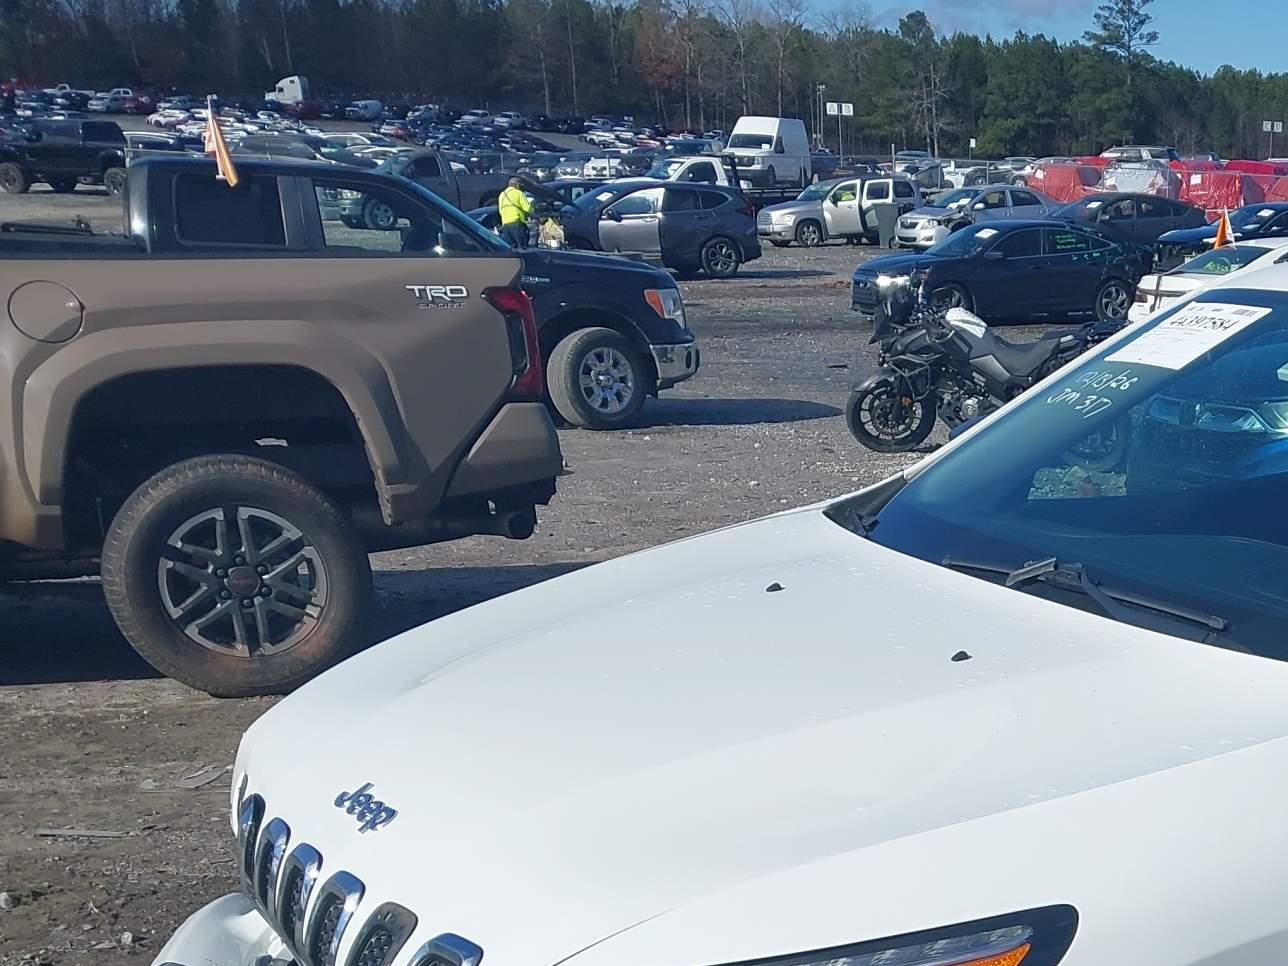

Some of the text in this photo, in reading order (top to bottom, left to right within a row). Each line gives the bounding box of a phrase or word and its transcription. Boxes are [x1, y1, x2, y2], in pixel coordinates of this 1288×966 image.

[828, 103, 836, 113] A
[844, 104, 852, 114] B
[405, 285, 469, 301] TRD
[334, 782, 398, 834] Jeep
